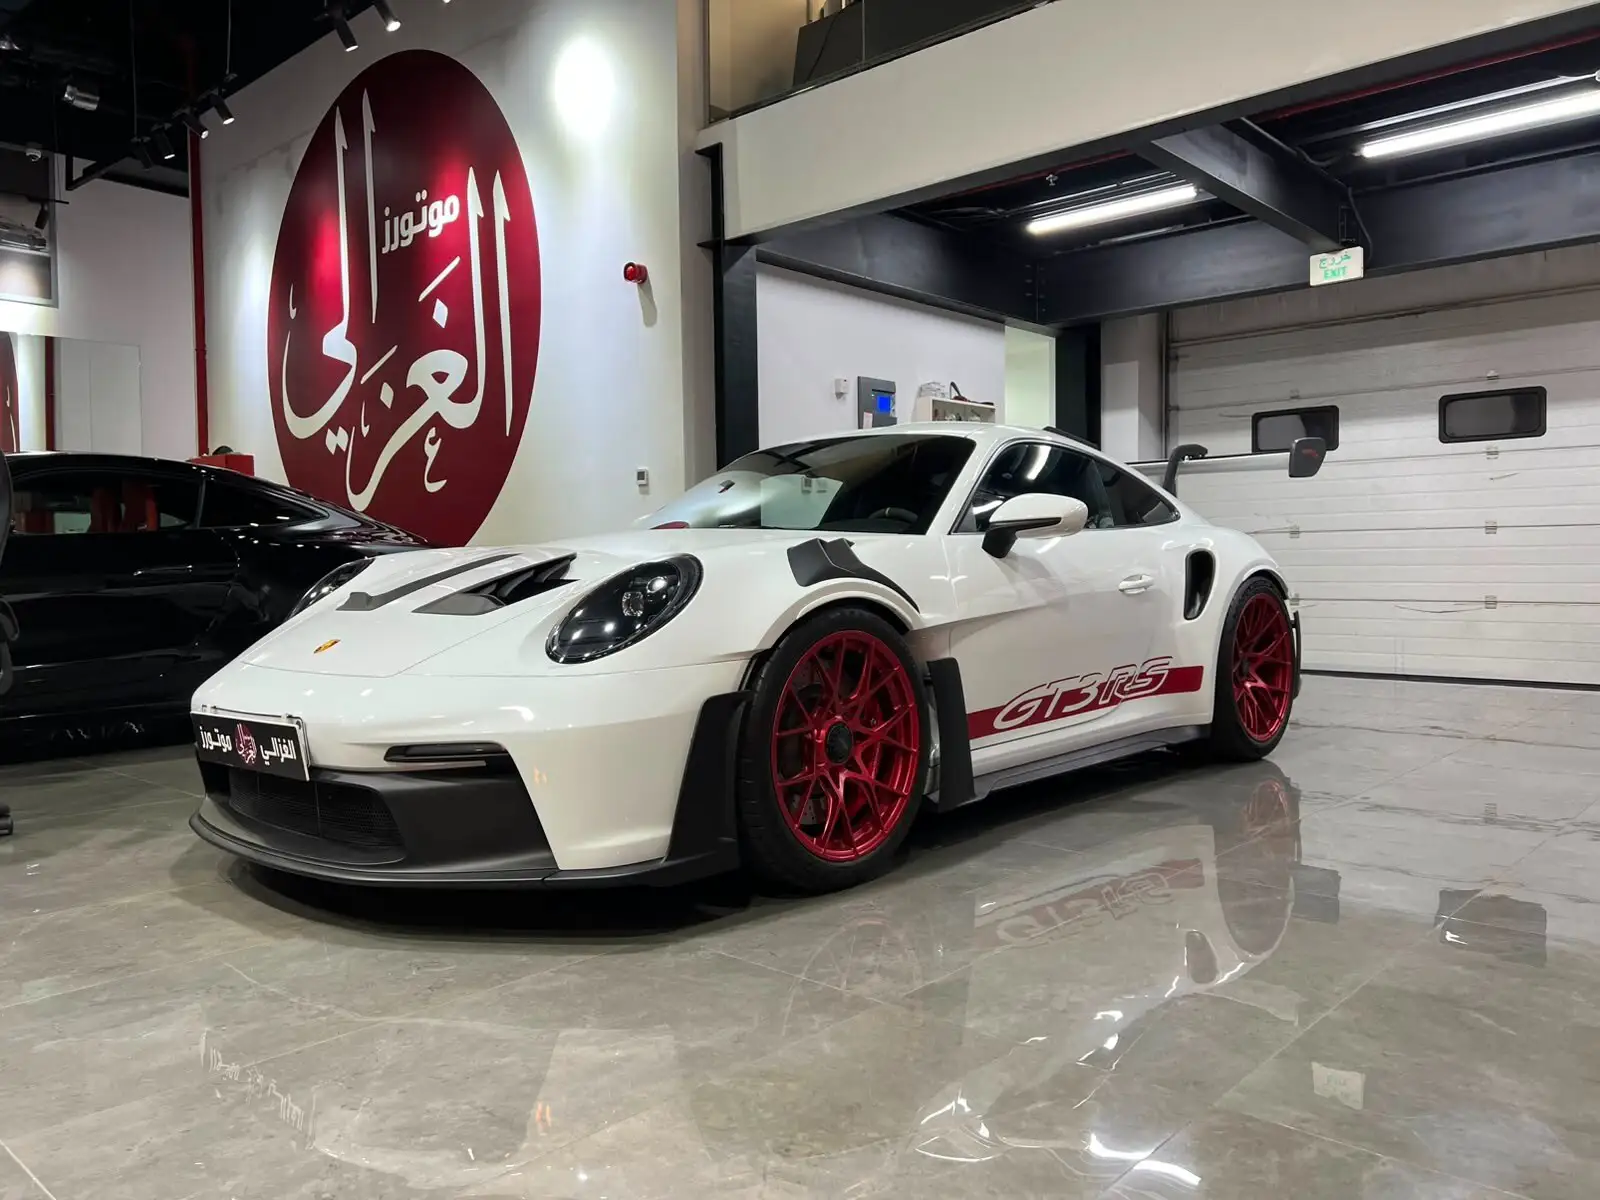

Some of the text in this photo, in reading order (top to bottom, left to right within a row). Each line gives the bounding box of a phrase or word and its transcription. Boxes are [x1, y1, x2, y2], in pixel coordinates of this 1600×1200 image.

[382, 189, 460, 254] موتورز
[1324, 266, 1347, 280] EXIT
[199, 725, 297, 766] الغزالي موتورز
